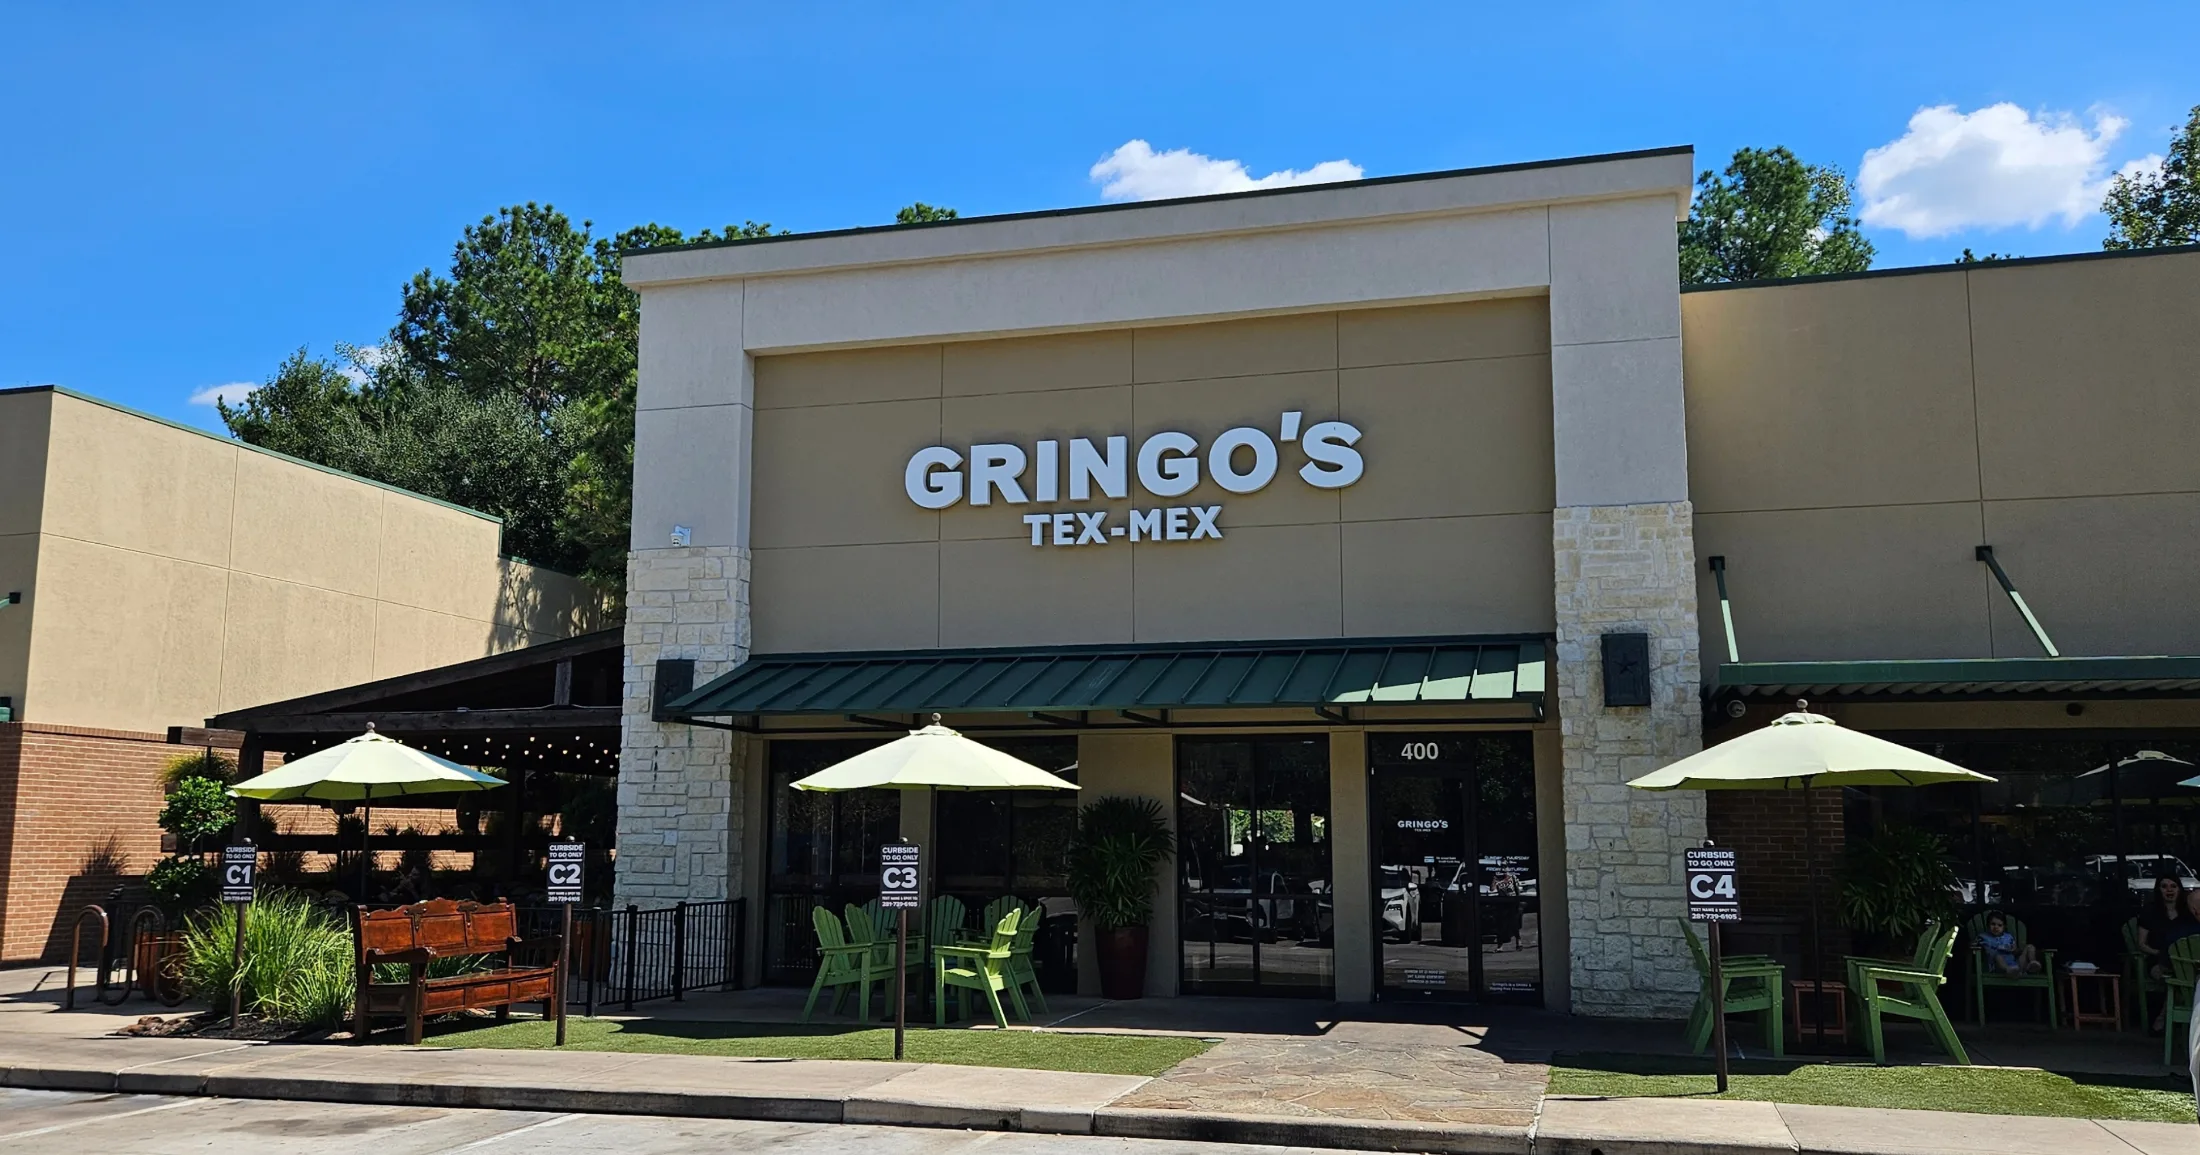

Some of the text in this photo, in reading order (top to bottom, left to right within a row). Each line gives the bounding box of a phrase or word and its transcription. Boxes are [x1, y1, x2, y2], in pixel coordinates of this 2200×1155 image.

[905, 411, 1364, 510] GRINGO'S
[1023, 505, 1224, 547] TEX-MEX
[1401, 742, 1439, 760] 400
[1397, 819, 1449, 829] GRINGO'S
[226, 864, 251, 884] C1
[549, 863, 581, 884] C2
[882, 867, 917, 889] C3
[1690, 874, 1736, 899] C4
